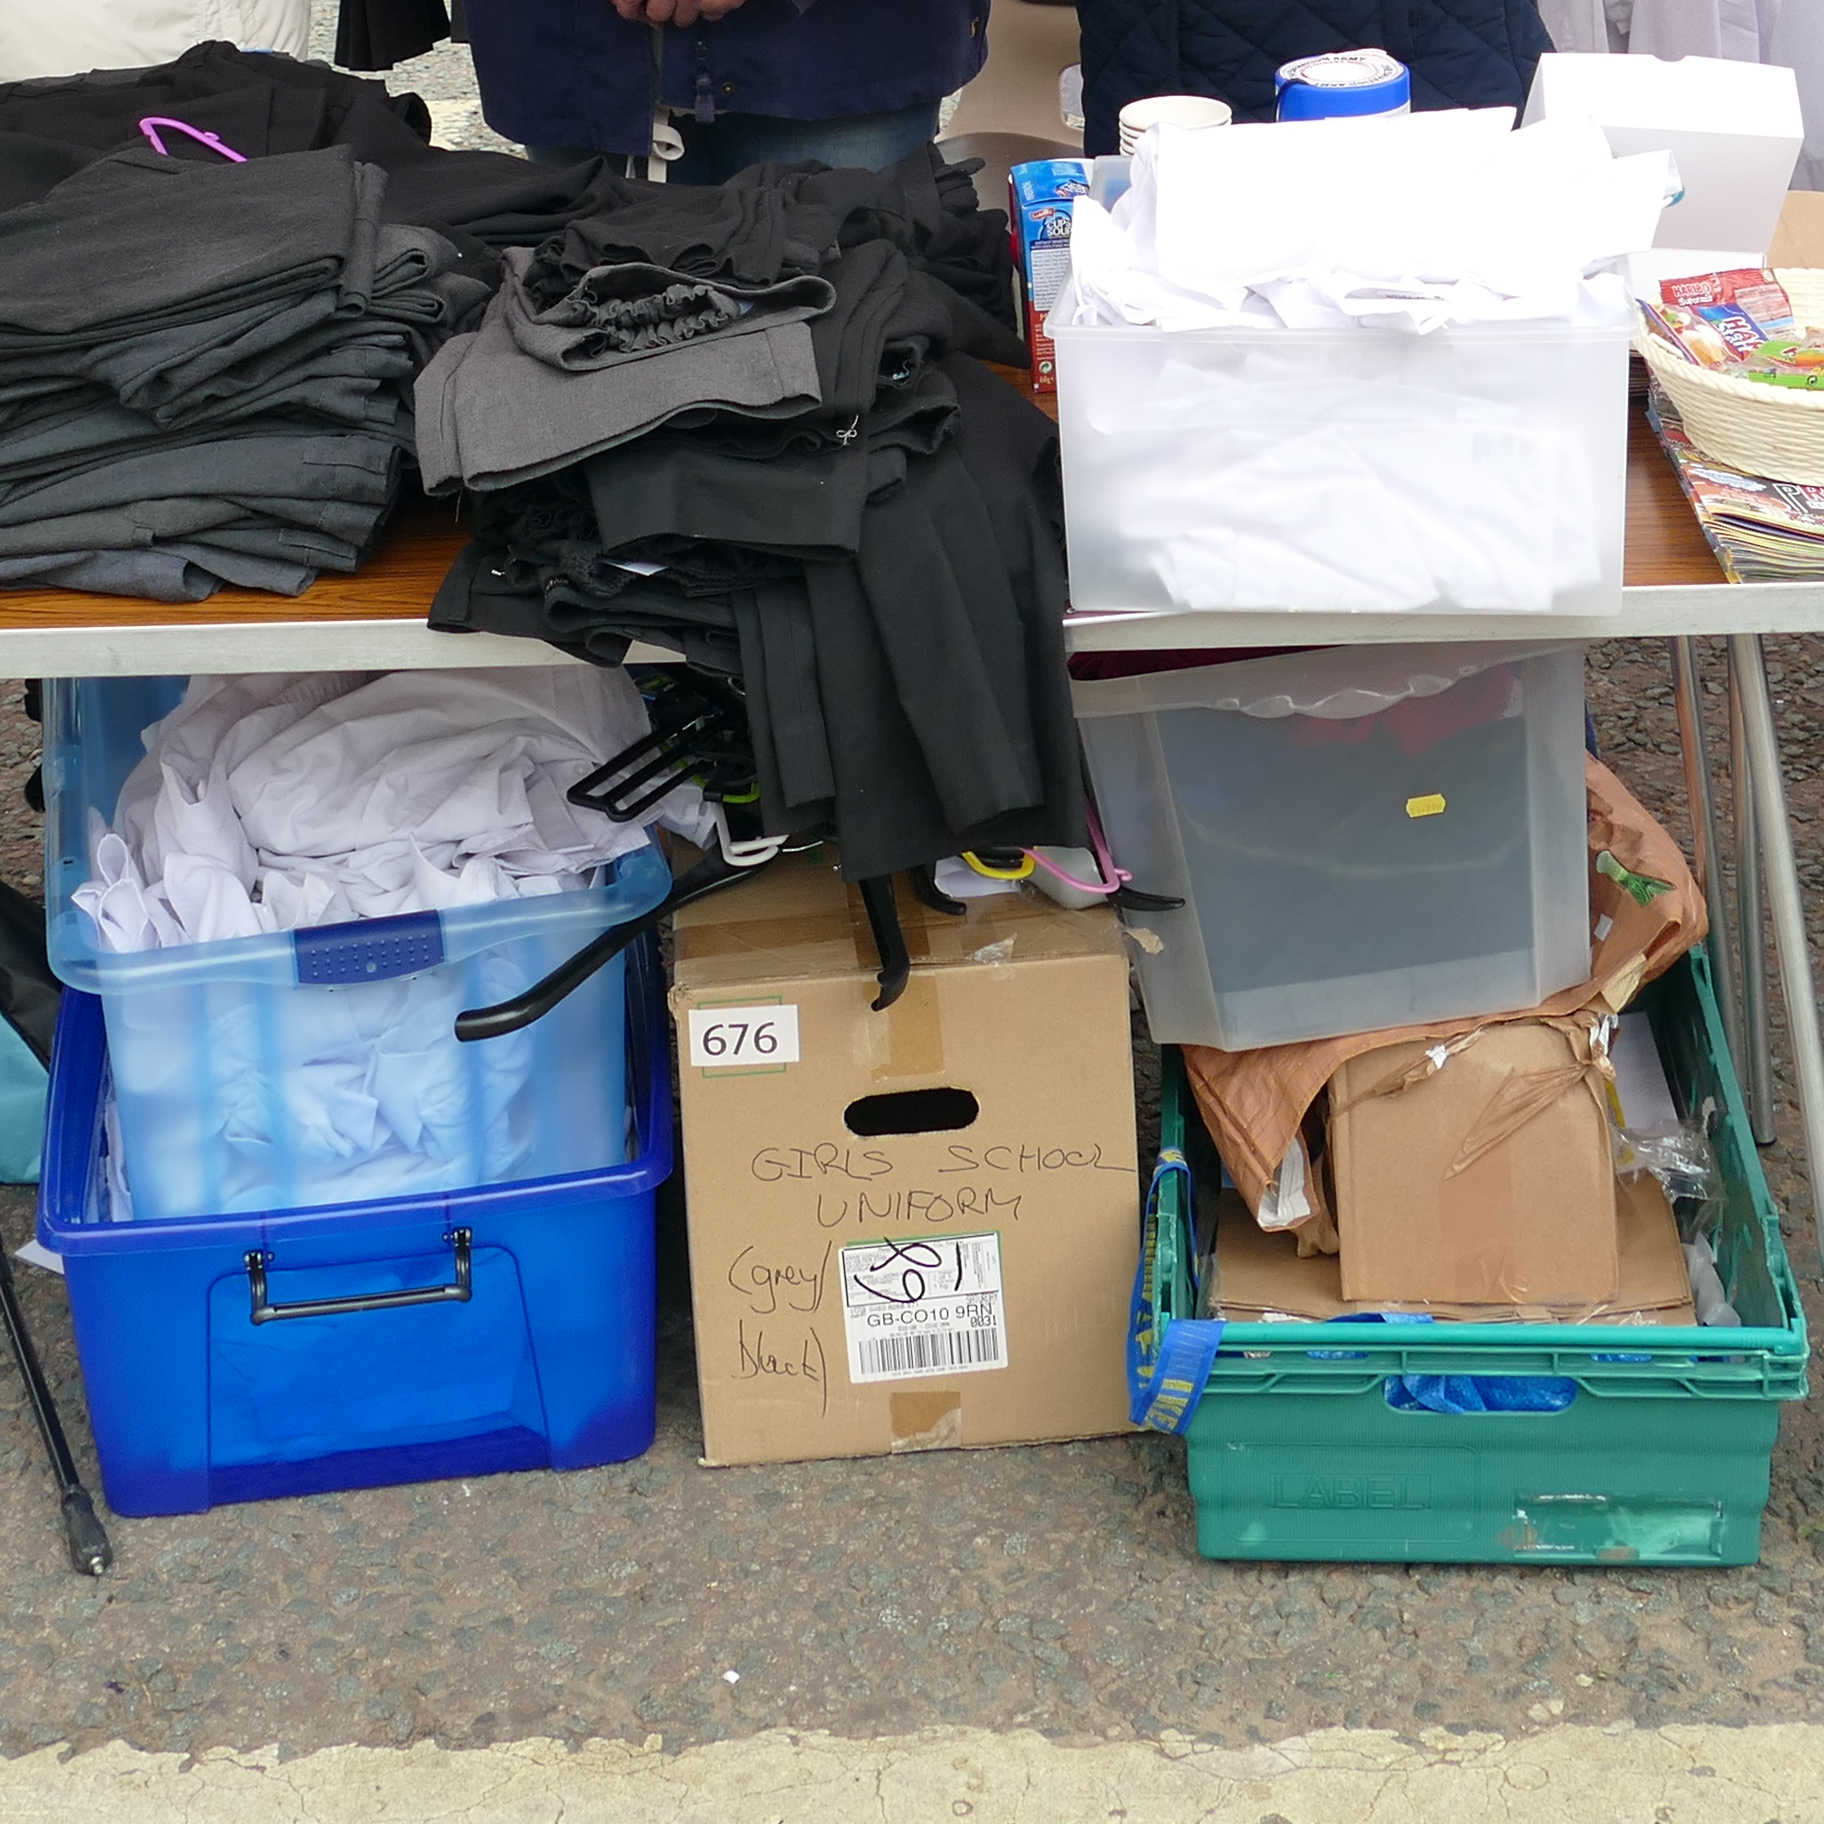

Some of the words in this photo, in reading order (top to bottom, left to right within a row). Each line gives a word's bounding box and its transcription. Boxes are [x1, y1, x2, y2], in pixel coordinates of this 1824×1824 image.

[702, 1021, 778, 1056] 676
[751, 1142, 894, 1181] GIRLS
[938, 1143, 1136, 1174] SCHOOL
[817, 1187, 1022, 1228] UNIFORM
[866, 1307, 950, 1328] GB-CO10
[1272, 1475, 1427, 1509] LABEL
